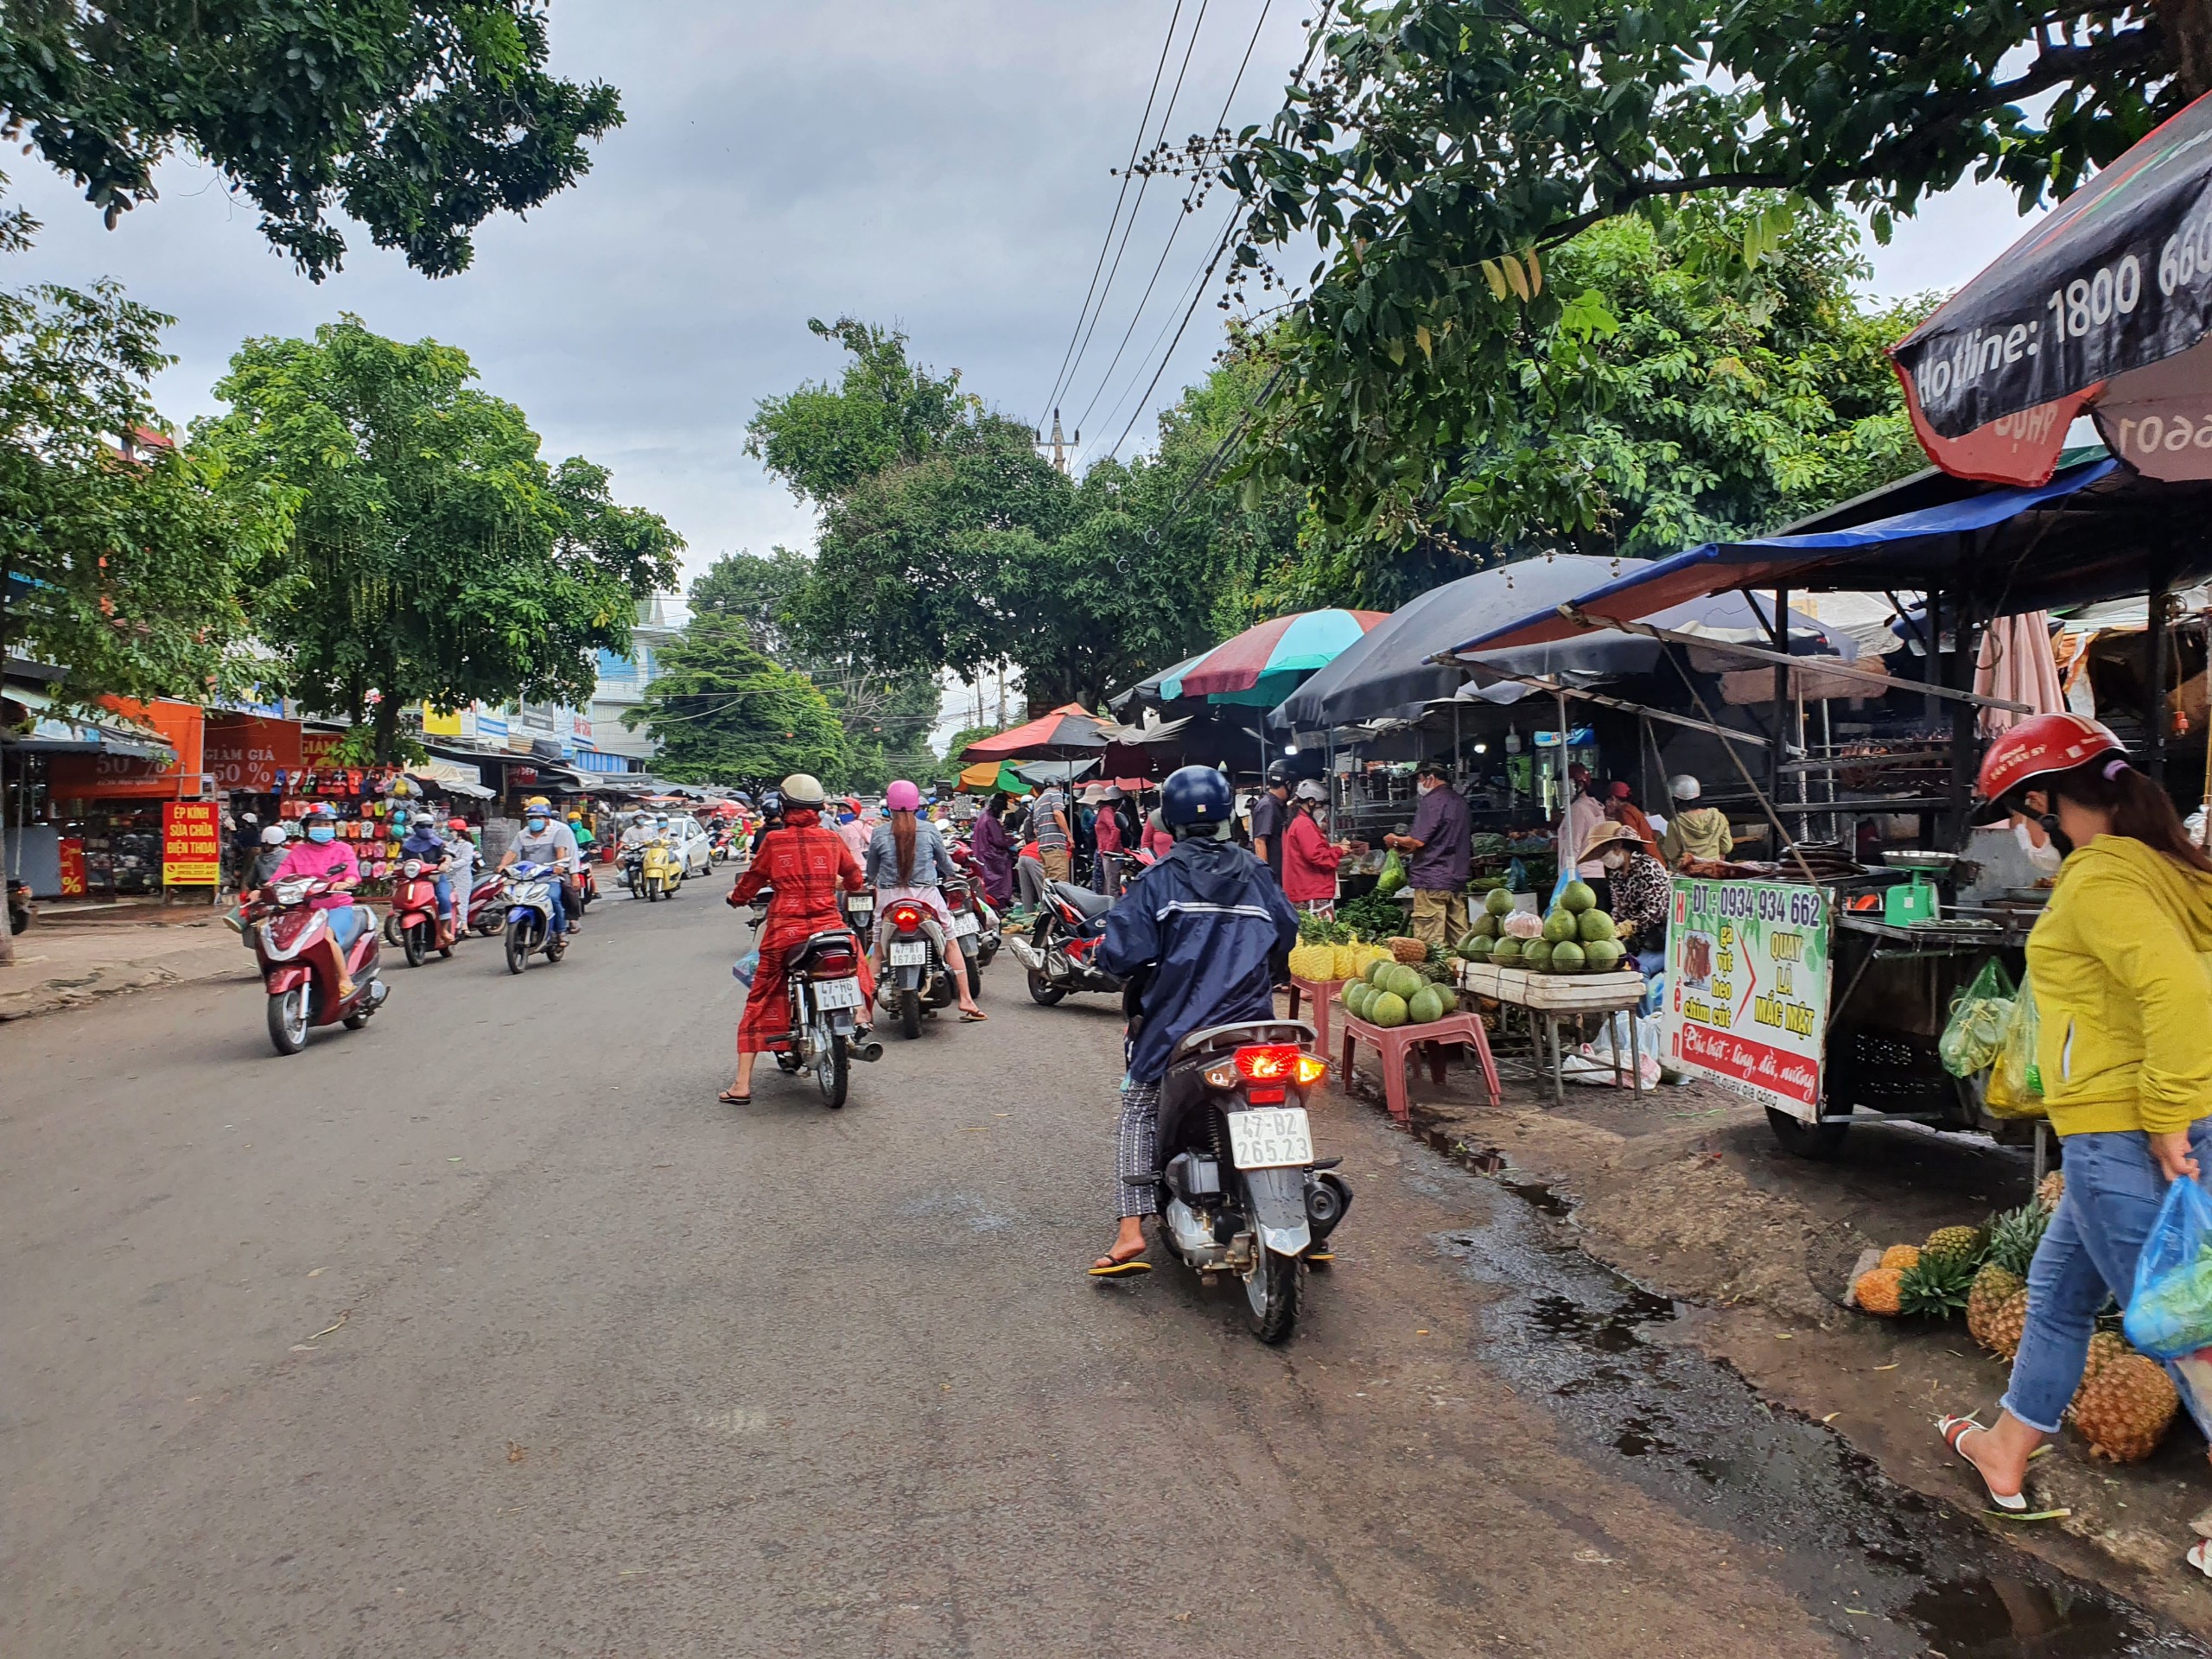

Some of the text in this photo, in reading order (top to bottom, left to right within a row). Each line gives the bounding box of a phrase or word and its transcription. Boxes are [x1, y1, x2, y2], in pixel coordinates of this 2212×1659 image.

[1917, 321, 2039, 409] Hotline:
[2047, 254, 2141, 344] 1800
[203, 744, 276, 760] GIẢM GIÁ
[213, 761, 270, 784] 50 %
[1719, 886, 1754, 918] 0934
[1758, 889, 1785, 922] 934
[1790, 893, 1821, 927] 662
[1720, 919, 1733, 949] gà
[1770, 931, 1803, 963] QUAY
[893, 954, 923, 964] 167.89
[1716, 950, 1733, 977] vịt
[1711, 974, 1732, 1001] heo
[1776, 963, 1793, 996] LÁ
[823, 993, 854, 1007] 4141
[1684, 996, 1732, 1029] chim cút
[1754, 989, 1815, 1040] MẮC MẬT
[1243, 1112, 1298, 1139] 47-B2
[1237, 1137, 1309, 1165] 265.23
